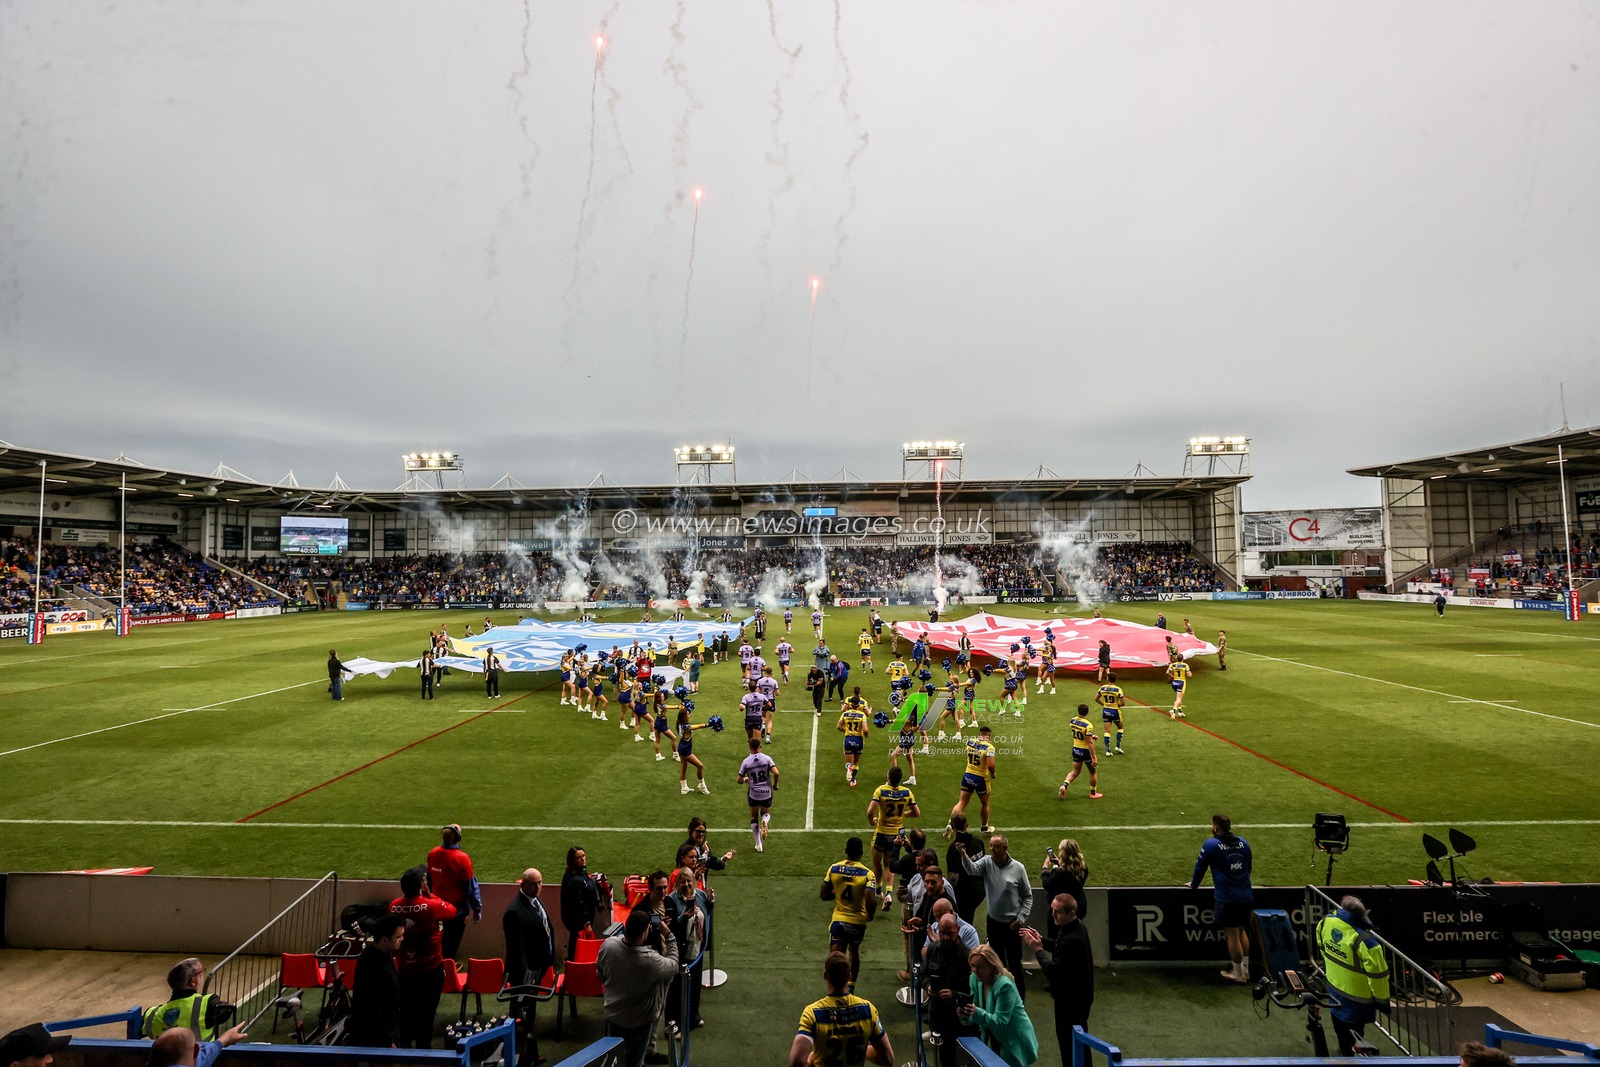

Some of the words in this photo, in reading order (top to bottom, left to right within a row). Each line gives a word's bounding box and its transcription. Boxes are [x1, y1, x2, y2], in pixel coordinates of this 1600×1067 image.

[701, 539, 728, 547] Jones
[900, 535, 941, 543] HALLIWELL
[949, 535, 971, 543] JONES
[763, 688, 769, 696] 5
[1103, 695, 1115, 704] 19
[968, 753, 981, 767] 15
[750, 771, 766, 784] 18
[885, 803, 905, 817] 21
[841, 884, 853, 902] 4
[391, 903, 428, 913] DOCTOR
[1423, 910, 1484, 924] Flexble
[1326, 943, 1348, 959] ROSS
